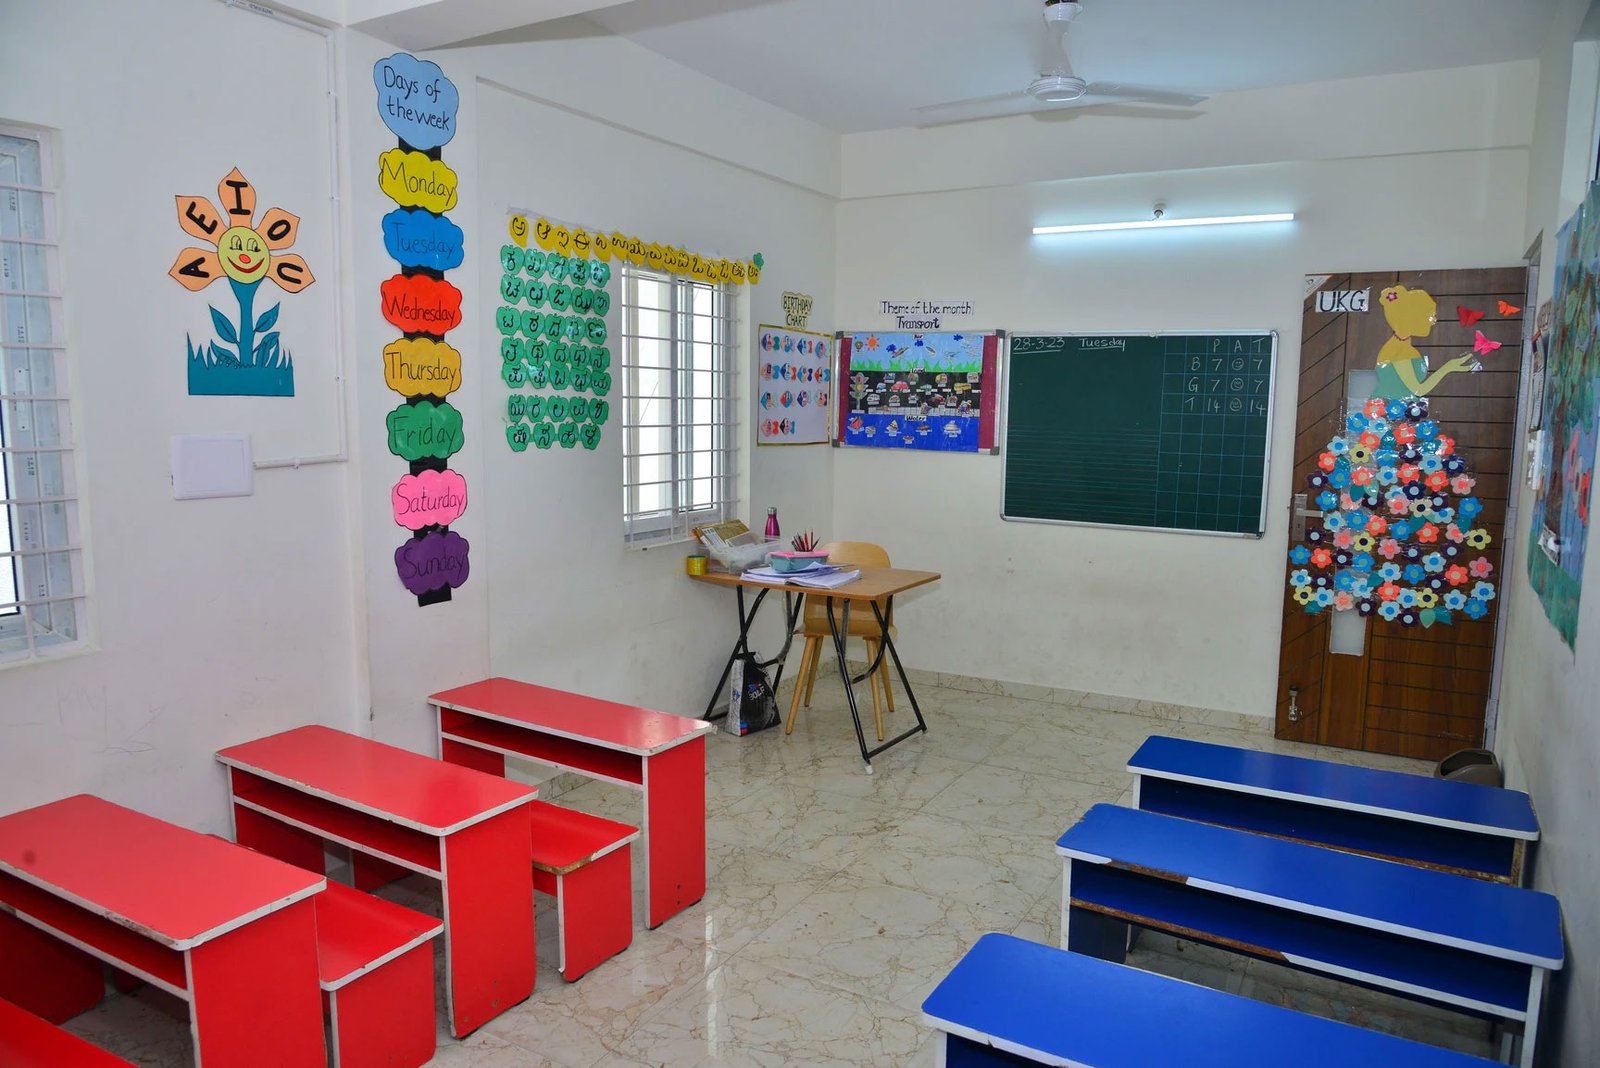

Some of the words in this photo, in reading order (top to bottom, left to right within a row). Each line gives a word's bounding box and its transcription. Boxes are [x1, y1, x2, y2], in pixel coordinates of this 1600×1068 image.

[383, 65, 419, 100] Days
[425, 78, 441, 104] of
[386, 95, 413, 122] the
[380, 158, 455, 207] Monday
[225, 180, 251, 216] I
[185, 201, 218, 235] E
[267, 219, 291, 241] O
[391, 221, 455, 260] Tuesday
[179, 256, 210, 278] A
[276, 262, 303, 285] U
[382, 290, 456, 324] Wednesday
[783, 295, 812, 314] BIRTHDAY
[882, 300, 909, 314] Theme
[910, 300, 921, 314] of
[923, 301, 940, 314] the
[942, 301, 971, 315] month
[1319, 290, 1366, 312] UKG
[896, 315, 940, 330] Transport
[1079, 337, 1126, 352] Tuesday
[1213, 338, 1221, 353] P
[1234, 339, 1242, 353] A
[1252, 337, 1265, 353] T
[386, 351, 457, 390] Thursday
[1191, 356, 1201, 371] B
[1211, 358, 1223, 371] 7
[1252, 358, 1263, 371] 7
[1188, 376, 1199, 393] G
[1210, 379, 1220, 392] 7
[1254, 379, 1264, 393] 7
[1184, 396, 1195, 412] T
[1207, 397, 1220, 414] 14
[1250, 399, 1267, 417] 14
[393, 415, 457, 455] Friday
[396, 483, 465, 516] Saturday
[403, 551, 466, 580] Sunday
